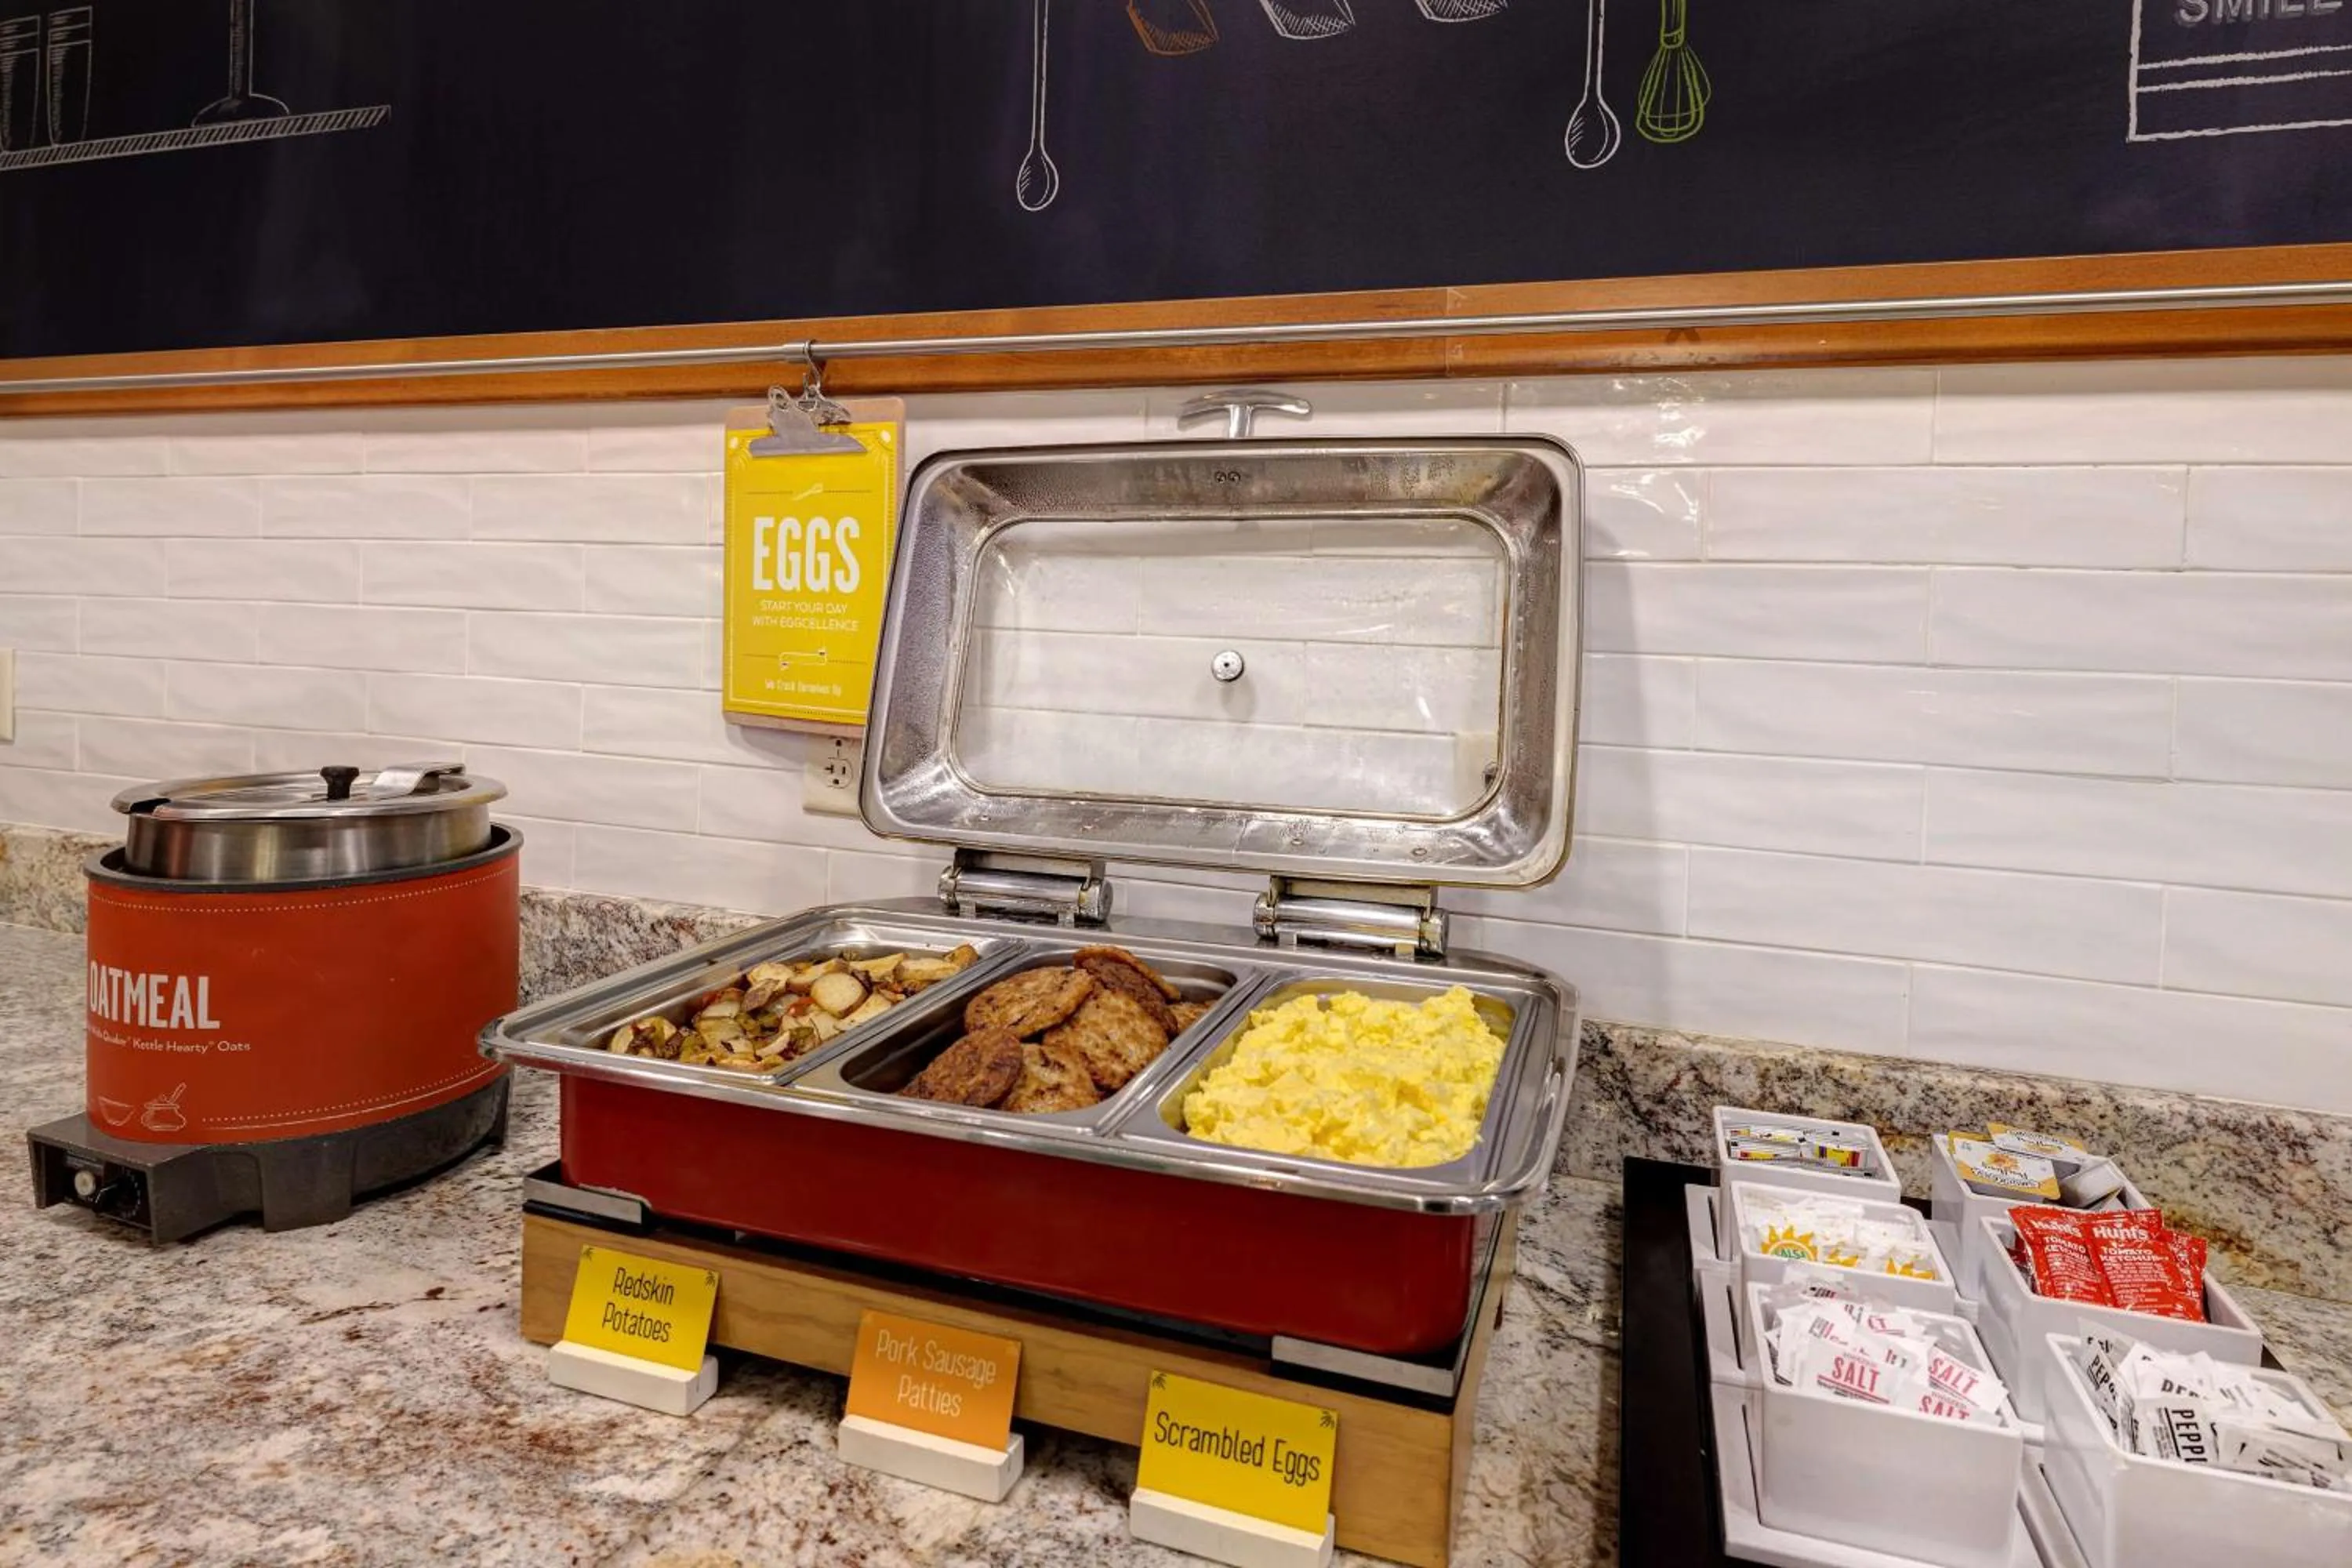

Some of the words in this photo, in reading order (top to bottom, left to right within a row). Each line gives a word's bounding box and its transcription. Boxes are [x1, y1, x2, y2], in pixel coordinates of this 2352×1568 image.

[753, 516, 860, 594] EGGS
[753, 615, 777, 626] WITH
[761, 599, 791, 612] START
[794, 601, 823, 613] YOUR
[826, 603, 848, 615] DAY
[90, 960, 220, 1029] OATMEAL
[132, 1039, 164, 1052] Kettle
[217, 1040, 251, 1052] Oats
[2103, 1247, 2153, 1256] TOMATO
[613, 1268, 674, 1305] Redskin
[601, 1301, 672, 1344] Potatoes
[876, 1330, 918, 1365] Pork
[923, 1340, 996, 1389] Sausage
[1831, 1356, 1881, 1392] SALT
[1928, 1357, 1979, 1394] SALT
[897, 1375, 963, 1417] Patties
[1154, 1410, 1265, 1468] Scrambled
[1272, 1439, 1322, 1487] Eggs
